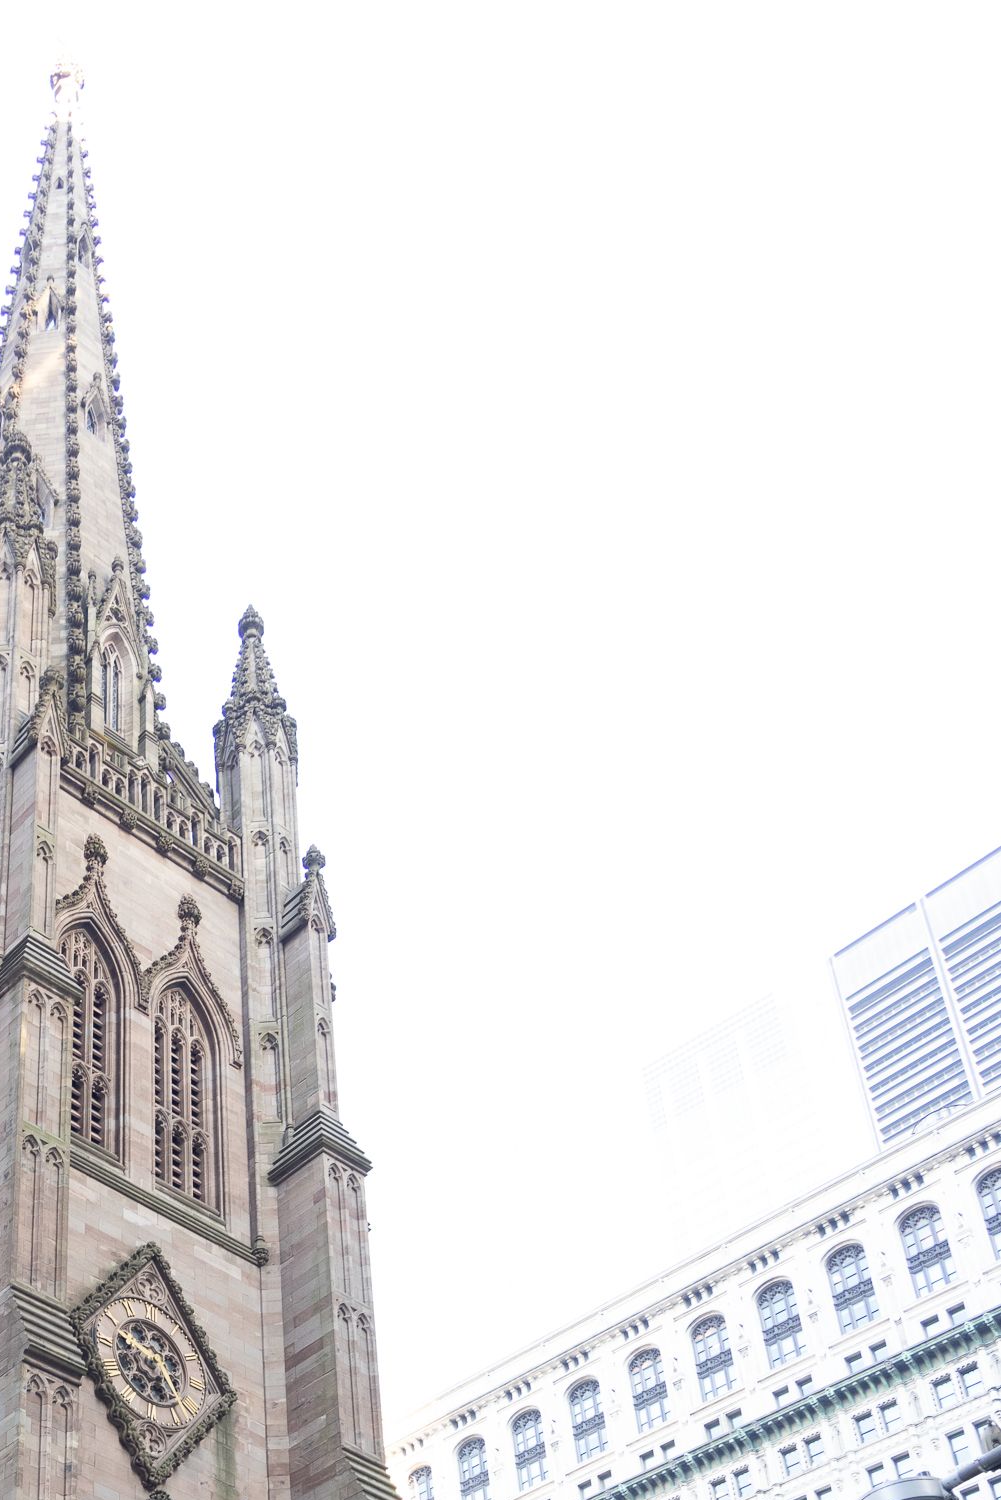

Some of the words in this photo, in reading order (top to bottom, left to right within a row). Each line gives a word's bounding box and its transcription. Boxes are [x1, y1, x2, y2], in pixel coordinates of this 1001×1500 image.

[104, 1308, 120, 1326] X
[122, 1300, 136, 1318] XI
[145, 1302, 158, 1322] XII
[97, 1334, 113, 1348] IX
[184, 1352, 198, 1361] II
[102, 1358, 121, 1377] VIII
[189, 1376, 205, 1391] III
[120, 1384, 137, 1404] VII
[147, 1402, 157, 1421] VI
